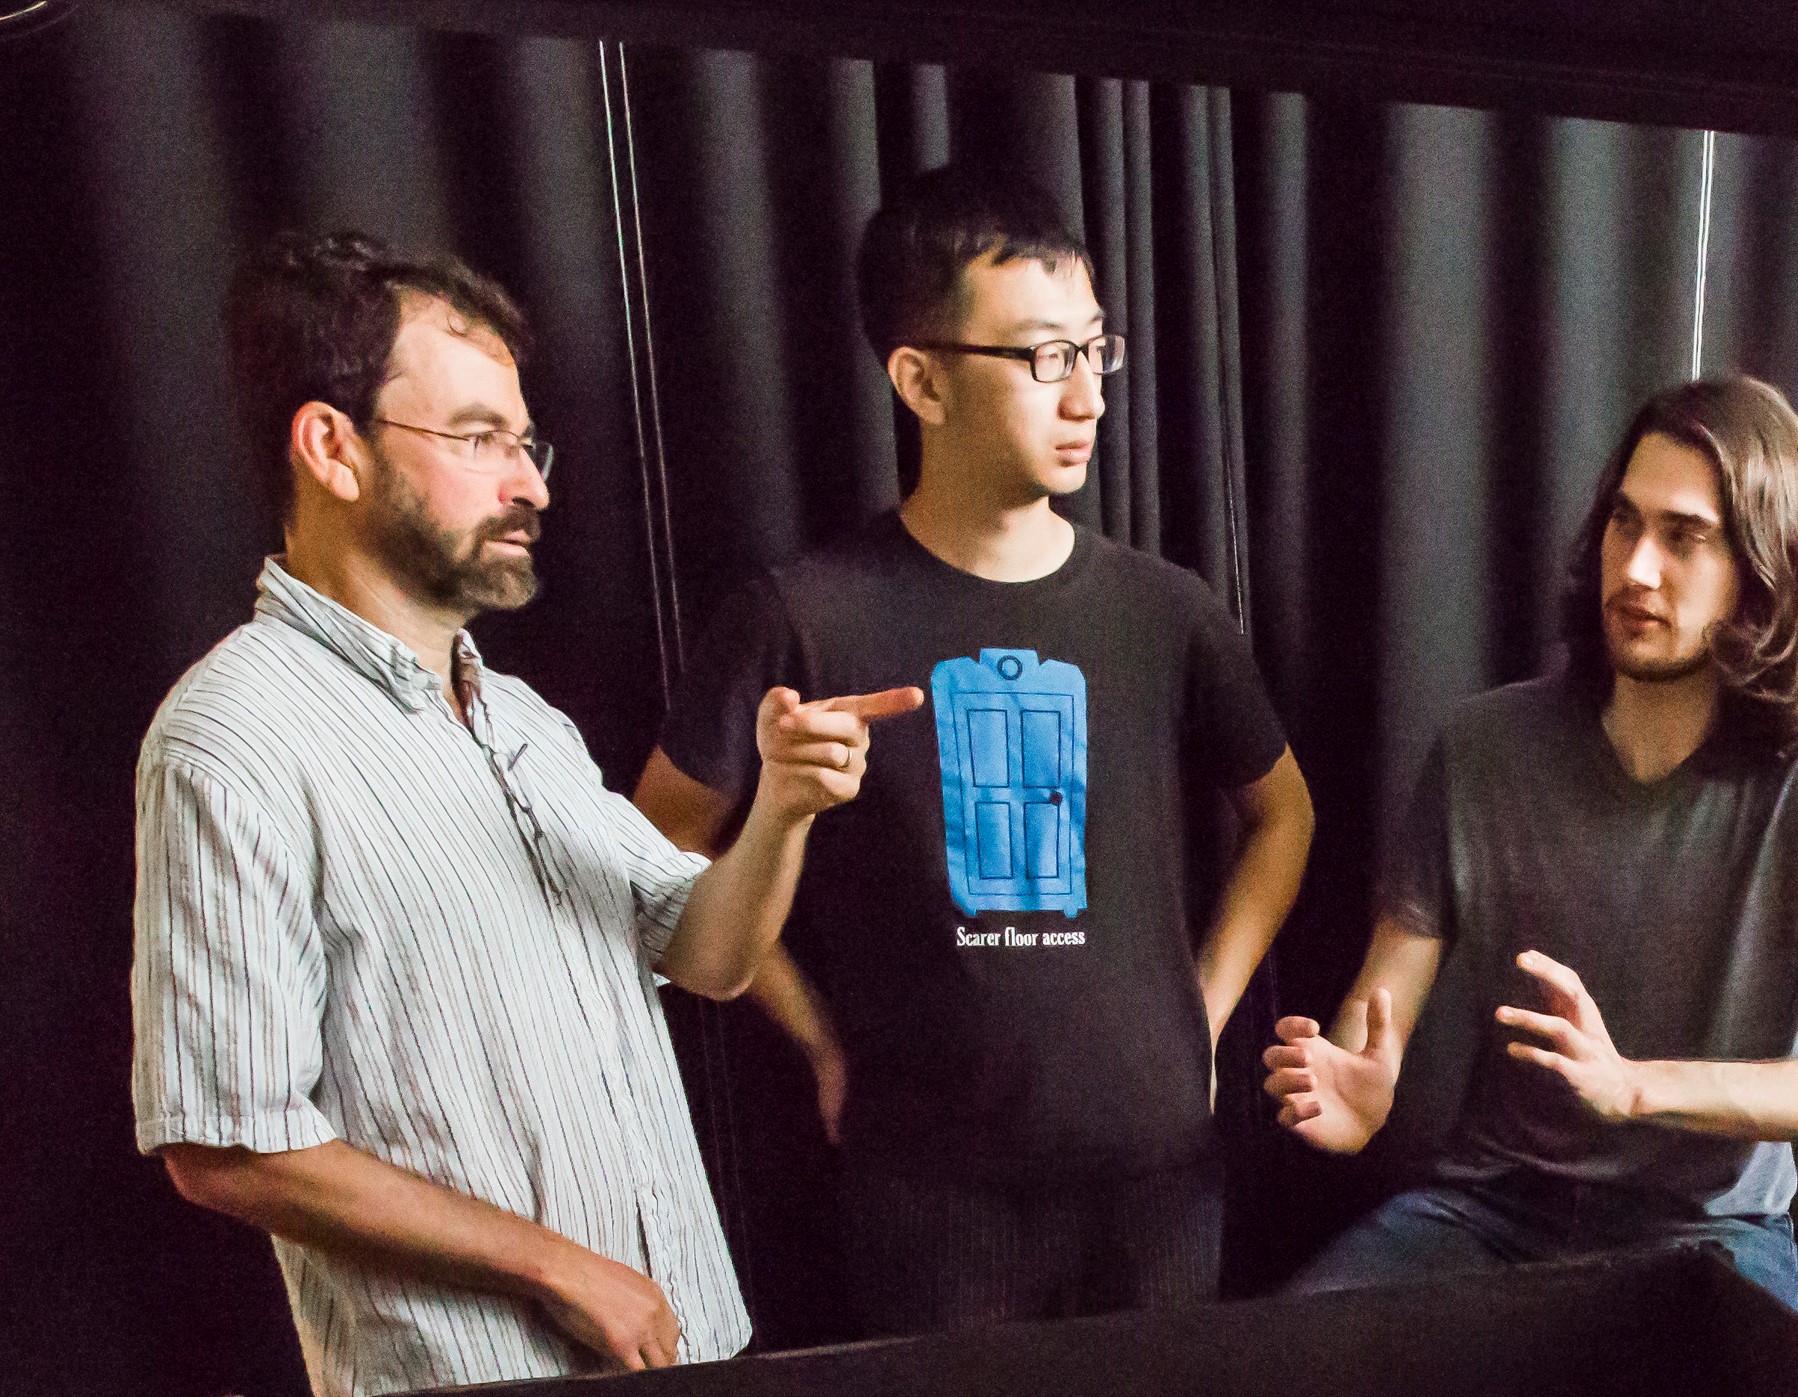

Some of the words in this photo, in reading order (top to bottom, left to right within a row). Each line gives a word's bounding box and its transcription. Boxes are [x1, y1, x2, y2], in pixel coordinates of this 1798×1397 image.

[957, 926, 1001, 947] Scarer
[1005, 926, 1039, 947] floor
[1042, 931, 1086, 946] access
